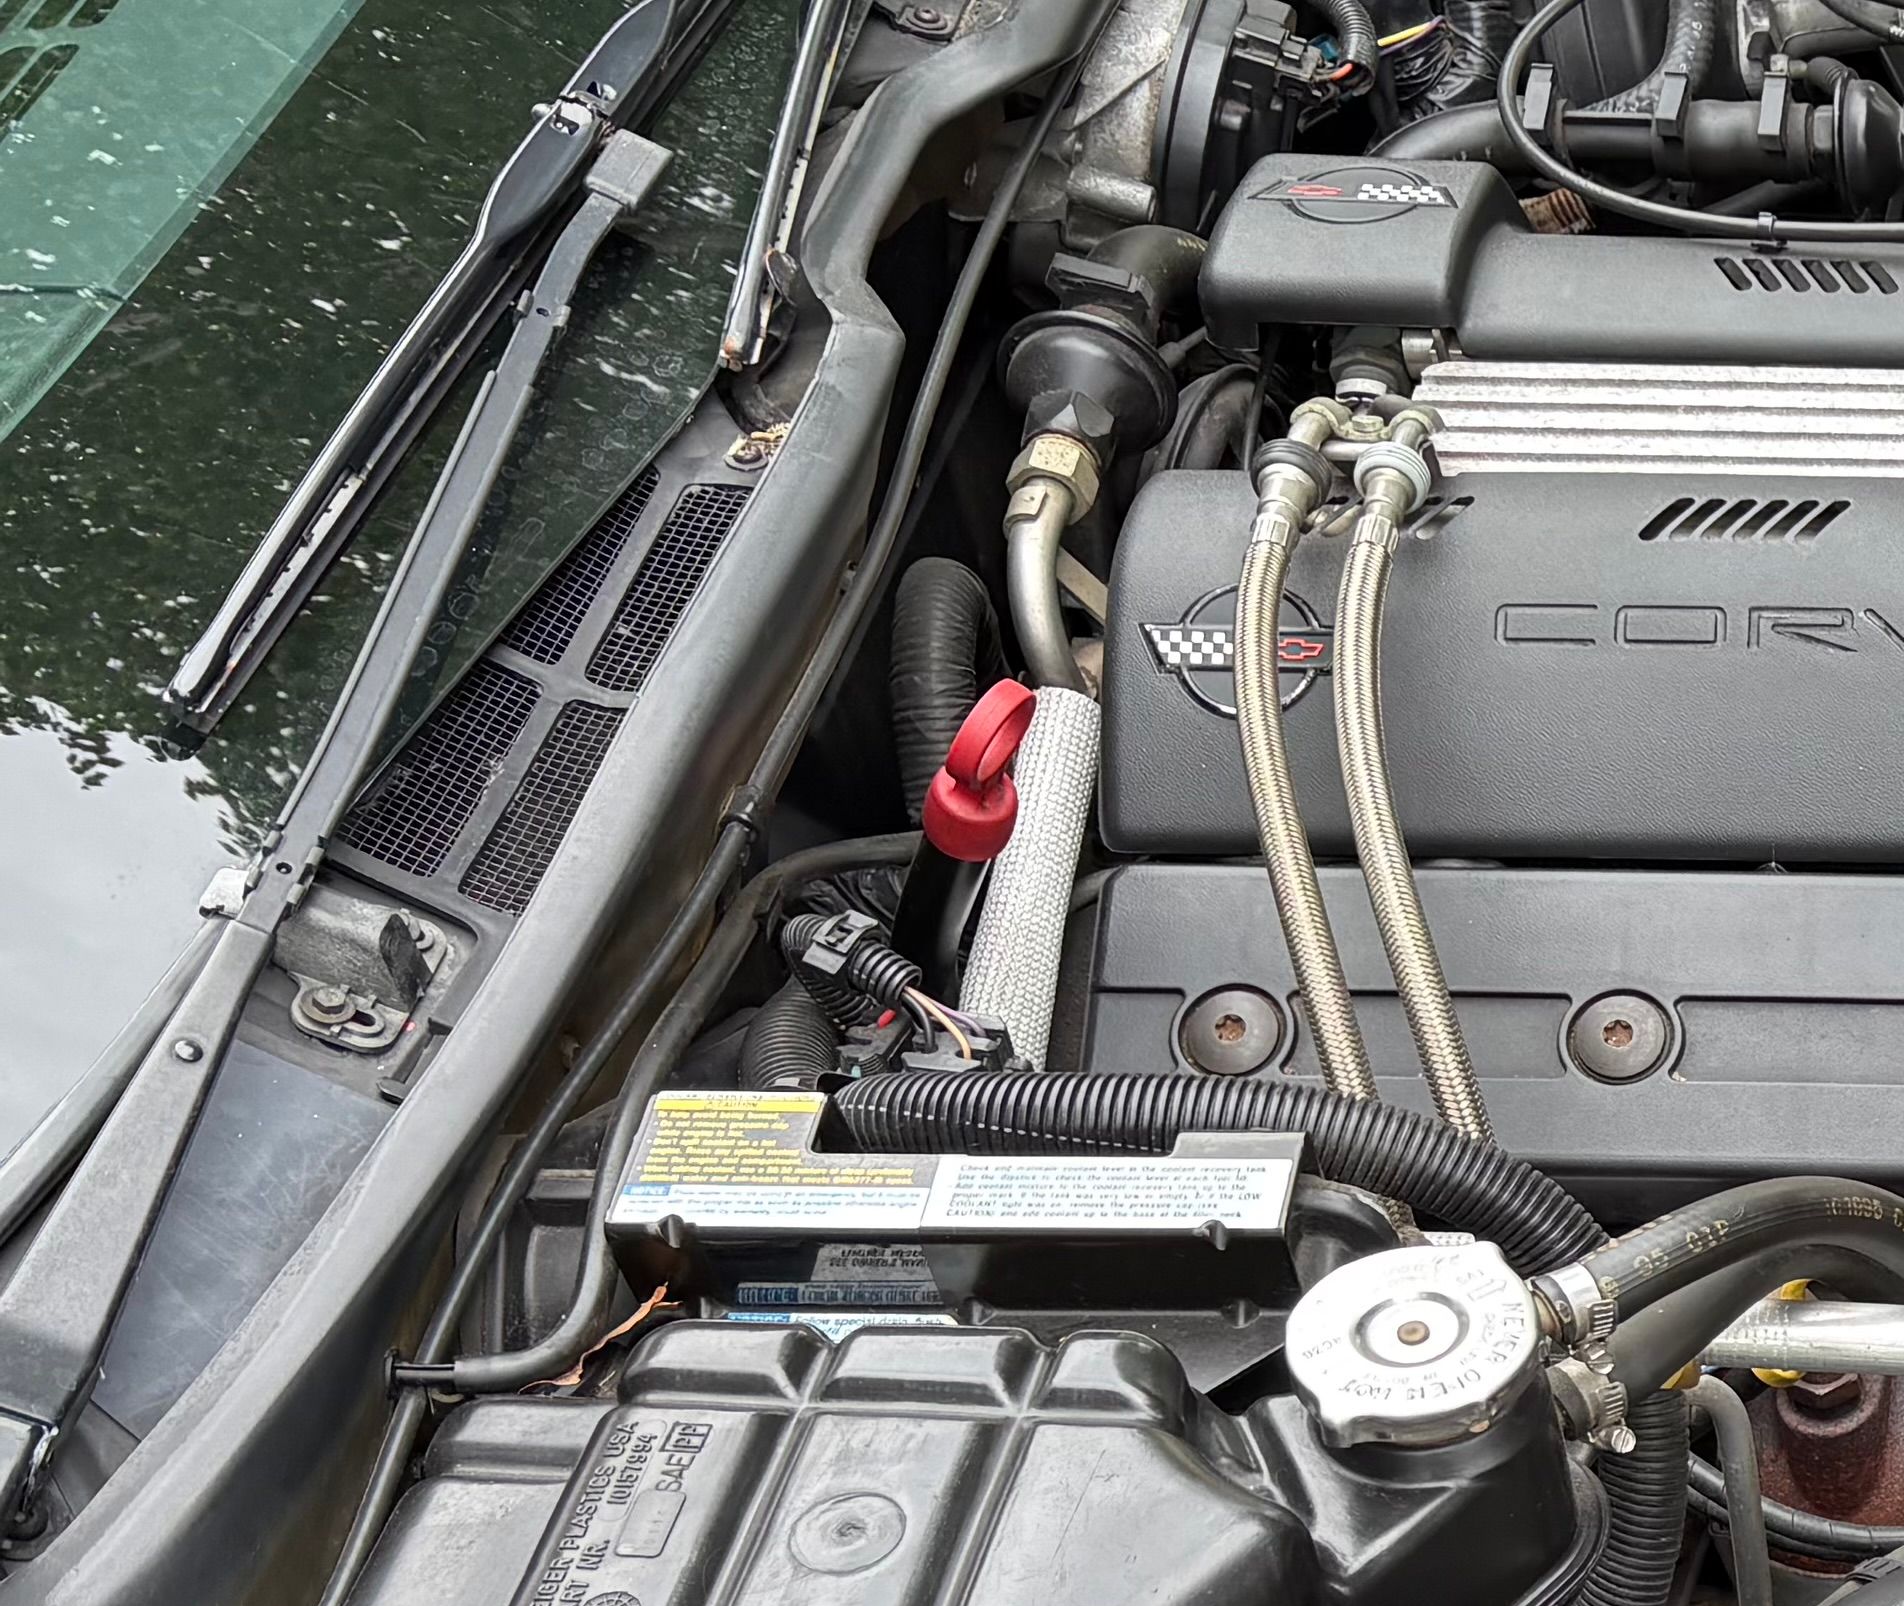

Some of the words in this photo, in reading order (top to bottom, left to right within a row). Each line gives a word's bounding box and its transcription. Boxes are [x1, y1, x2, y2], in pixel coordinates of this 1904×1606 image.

[1484, 1300, 1524, 1364] NEVER
[558, 1461, 617, 1555] PLASTICS
[607, 1420, 638, 1458] USA
[576, 1532, 611, 1575] NR.
[607, 1432, 656, 1505] 10157994
[655, 1446, 695, 1495] SAE
